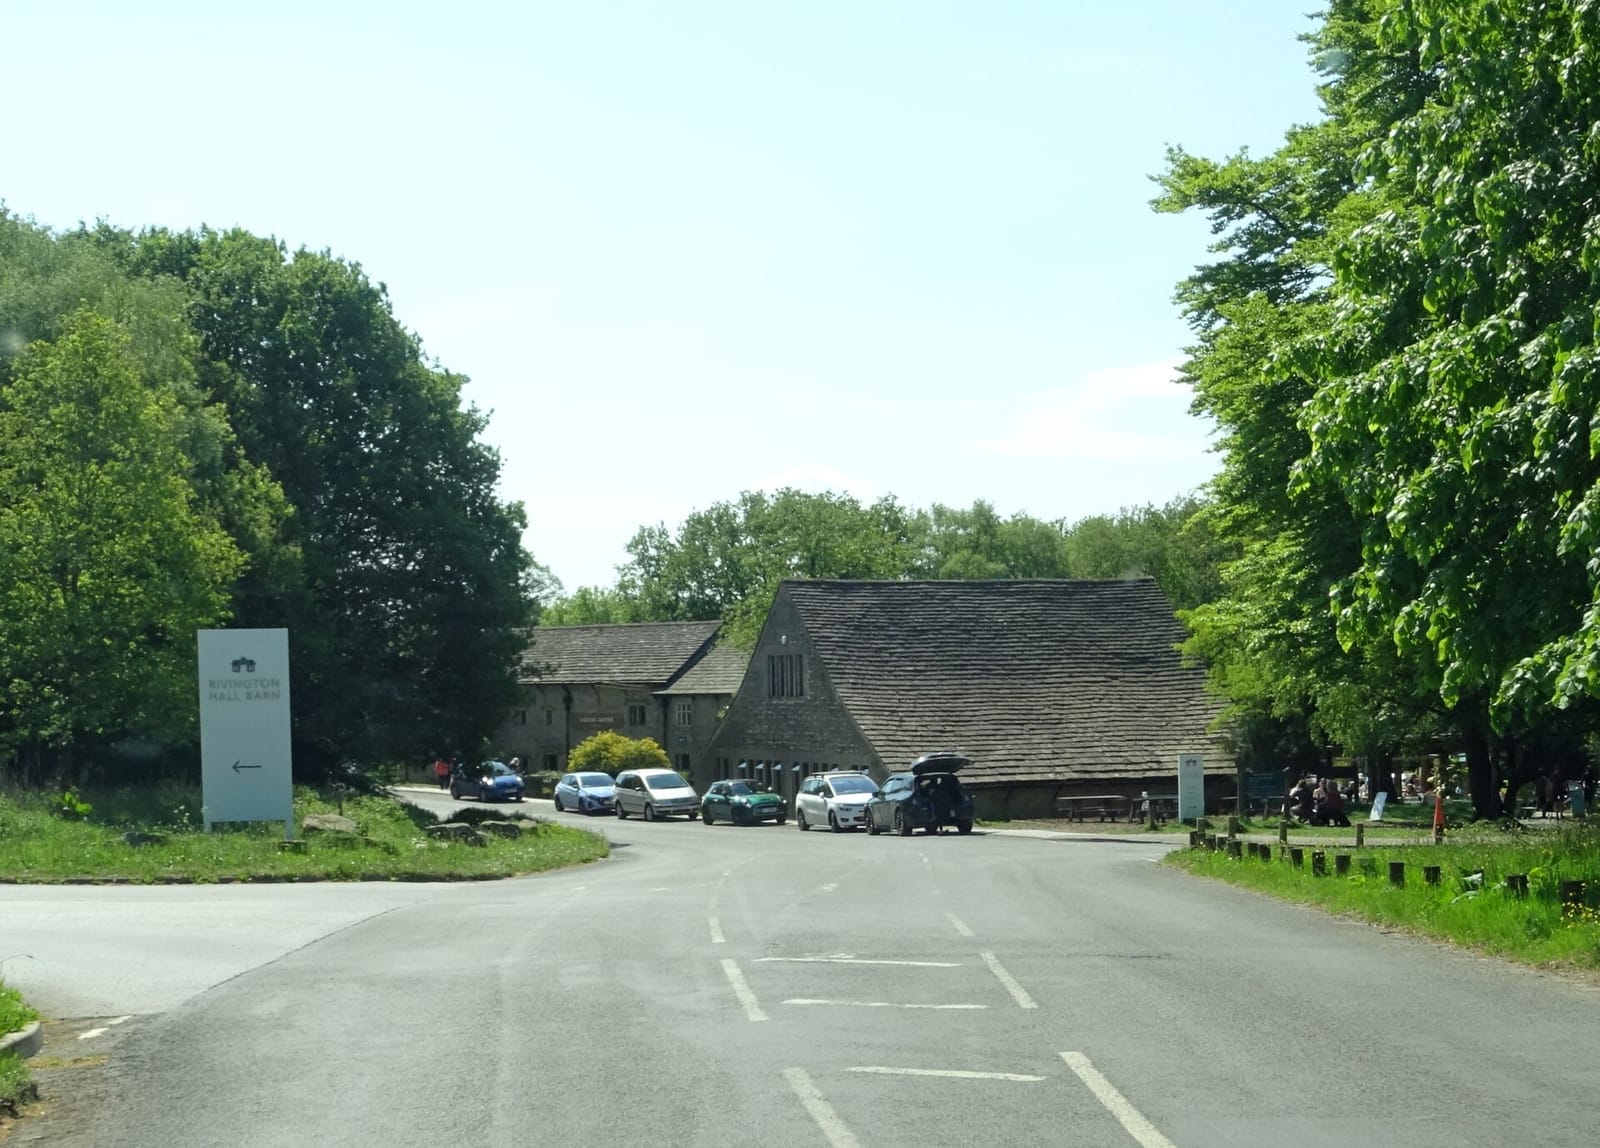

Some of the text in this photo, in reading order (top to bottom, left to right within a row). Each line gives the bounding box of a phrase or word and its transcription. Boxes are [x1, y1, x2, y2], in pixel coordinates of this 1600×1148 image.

[208, 679, 280, 689] RIVINGTON
[208, 690, 280, 701] HALL BARN
